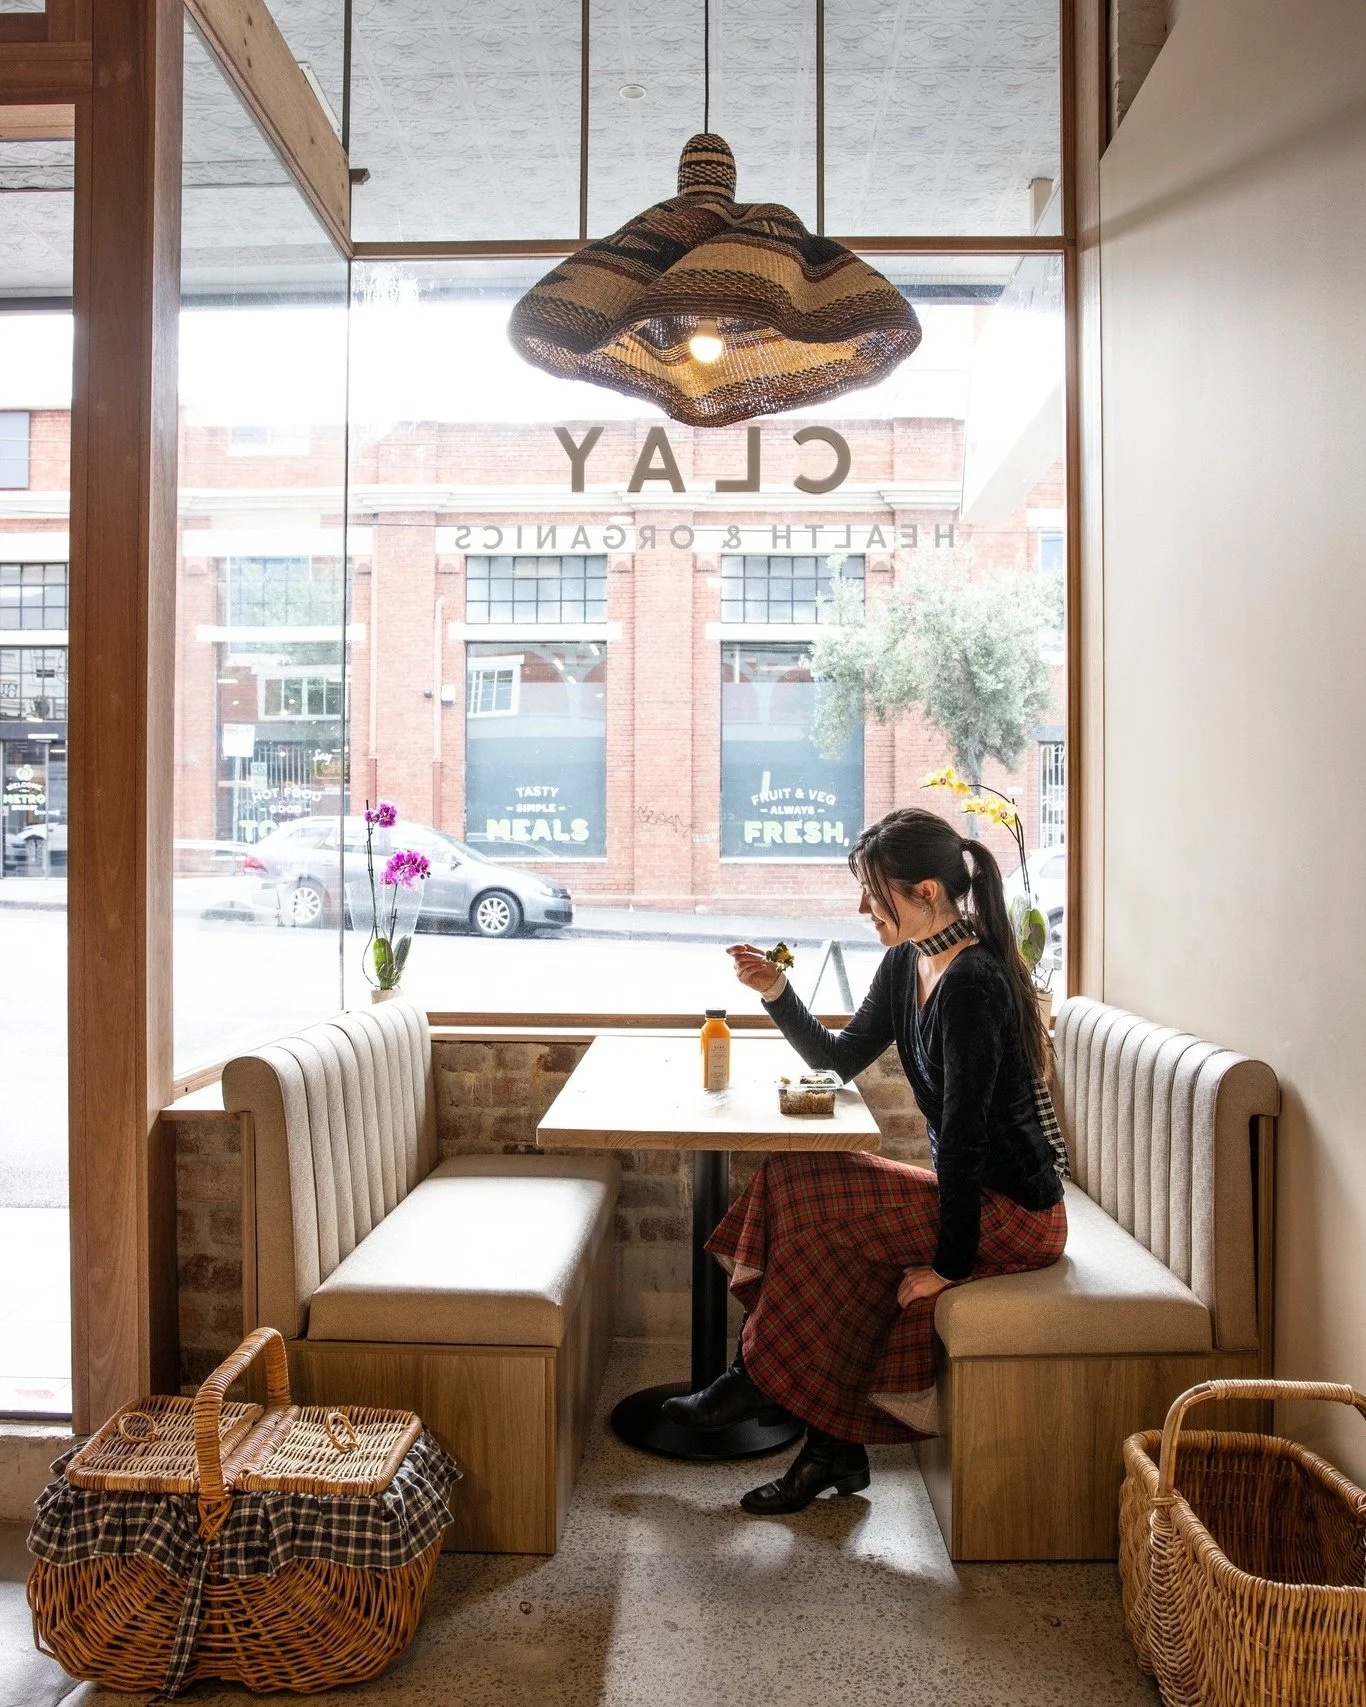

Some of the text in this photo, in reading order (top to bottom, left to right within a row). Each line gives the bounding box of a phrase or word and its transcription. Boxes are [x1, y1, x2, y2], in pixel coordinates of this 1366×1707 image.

[252, 787, 322, 802] HOT FOOD
[516, 786, 559, 798] TASTY
[750, 787, 836, 807] FRUIT & VEG
[3, 794, 45, 803] METRO
[269, 805, 302, 813] GOOD
[516, 804, 556, 812] SIMPLE
[769, 805, 815, 815] ALWAYS
[486, 817, 590, 843] MEALS
